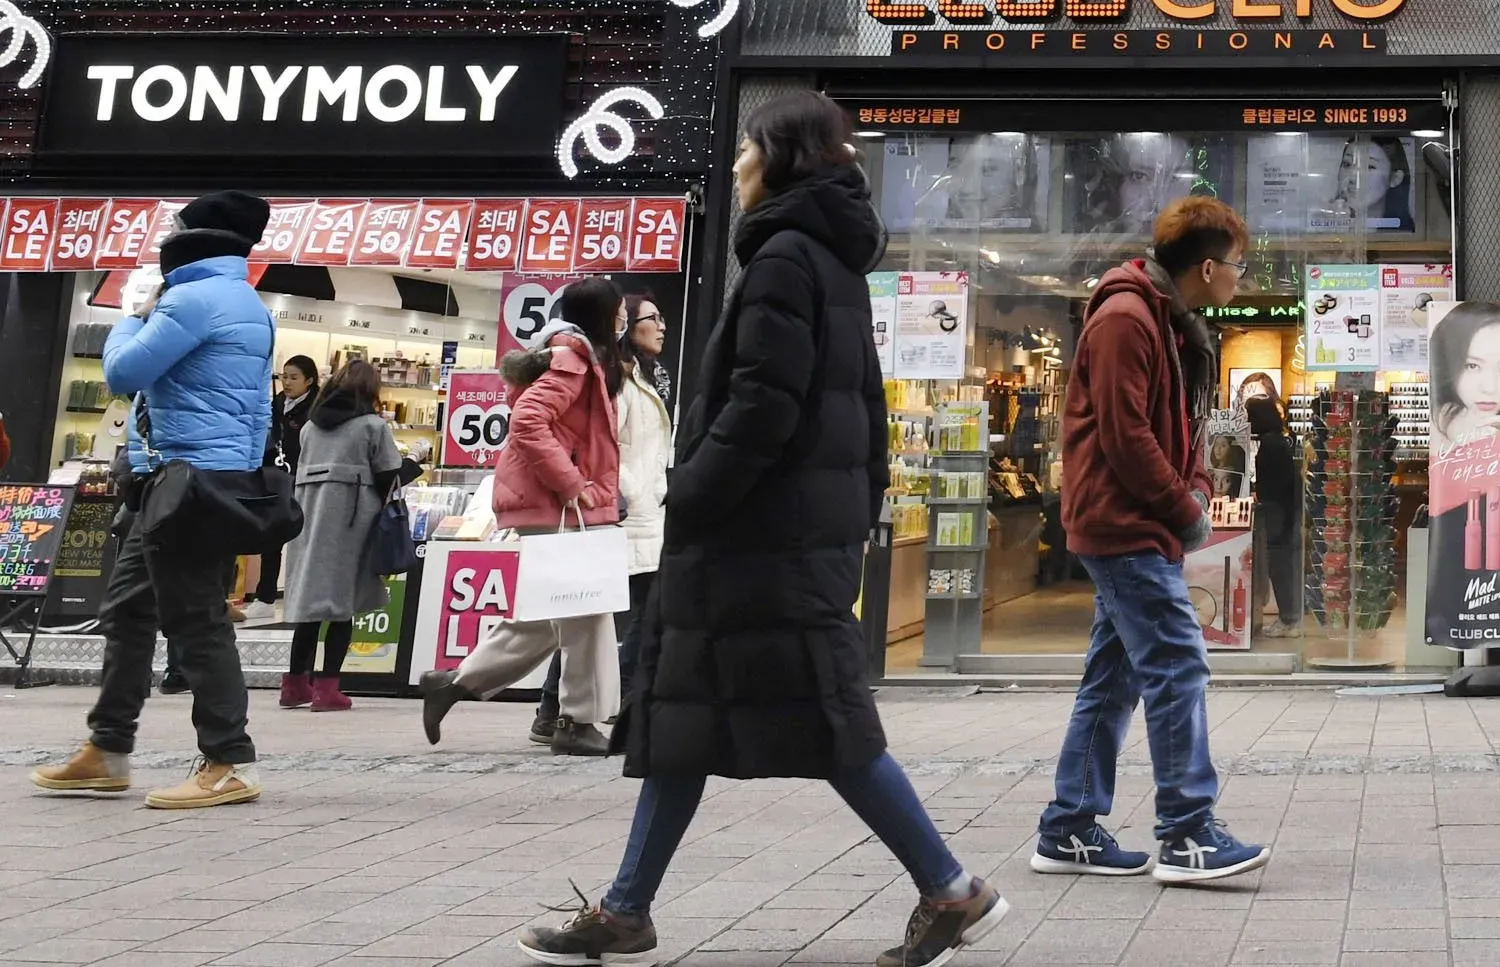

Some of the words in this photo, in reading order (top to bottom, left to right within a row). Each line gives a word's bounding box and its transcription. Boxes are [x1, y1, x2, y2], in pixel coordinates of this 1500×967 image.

[901, 33, 1376, 50] PROFESSIONAL
[87, 65, 519, 122] TONYMOLY
[859, 109, 960, 124] 명동성당길클럽
[1242, 109, 1316, 124] 클럽클리오
[1325, 109, 1367, 123] SINCE
[1372, 108, 1407, 123] 1993
[63, 209, 100, 232] 최대
[269, 207, 306, 230] 최대
[368, 209, 409, 230] 최대
[478, 210, 517, 232] 최대
[584, 210, 624, 232] 최대
[450, 568, 508, 612] SA
[1464, 573, 1497, 602] Mad
[1468, 594, 1490, 609] MATTE
